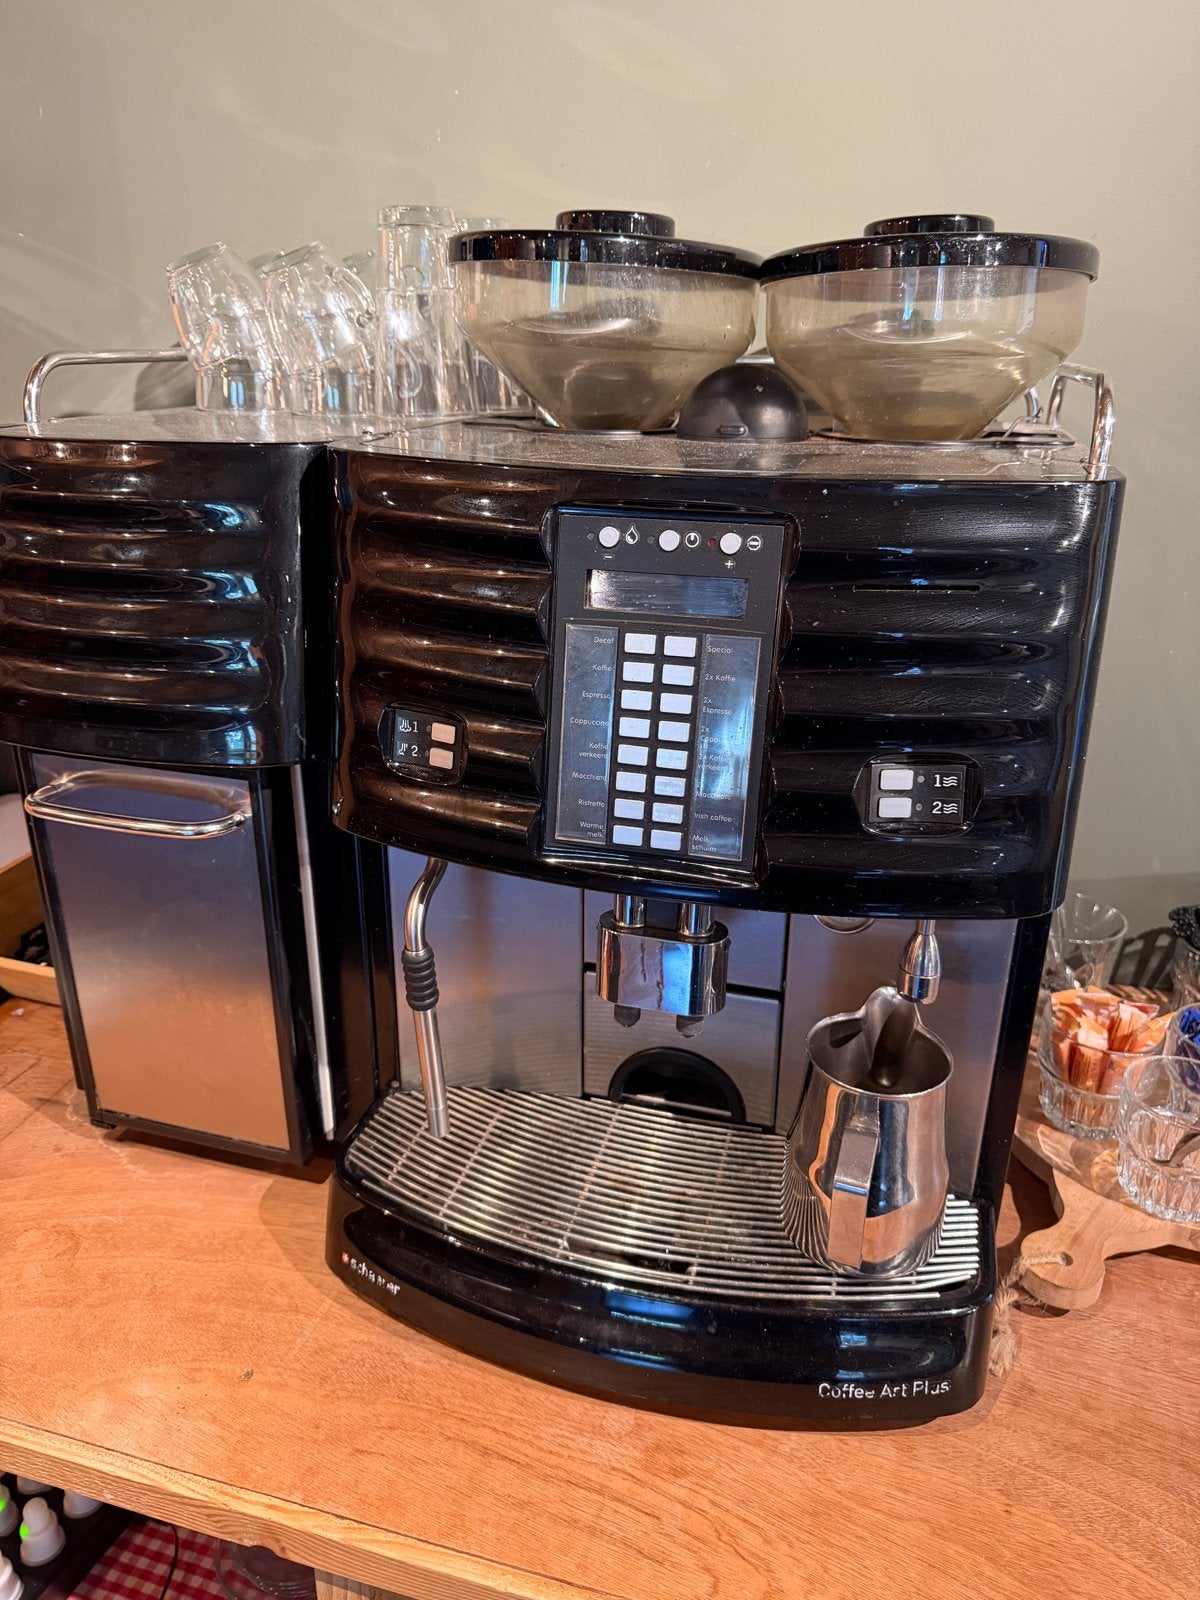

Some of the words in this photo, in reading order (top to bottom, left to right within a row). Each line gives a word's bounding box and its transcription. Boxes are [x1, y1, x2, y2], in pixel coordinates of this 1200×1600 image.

[594, 636, 614, 645] Decaf
[707, 645, 734, 654] Special
[592, 664, 612, 672] Koffie
[704, 673, 714, 681] 2x
[716, 674, 737, 683] Koffie
[582, 690, 611, 700] Espresso
[703, 696, 712, 704] 2x
[702, 706, 733, 716] Espresso
[412, 721, 419, 733] 1
[569, 716, 610, 728] Cappuccino
[700, 725, 710, 733] 2x
[411, 745, 419, 757] 2
[572, 771, 607, 782] Macchiato
[933, 774, 942, 787] 1
[578, 798, 605, 808] Ristretto
[932, 801, 942, 814] 2
[693, 812, 709, 820] Irish
[710, 814, 733, 823] coffee
[579, 820, 604, 830] Warme
[587, 831, 604, 839] melk
[692, 834, 709, 842] Melk
[691, 843, 716, 853] schuim
[818, 1382, 875, 1399] Coffee
[879, 1382, 909, 1399] Art
